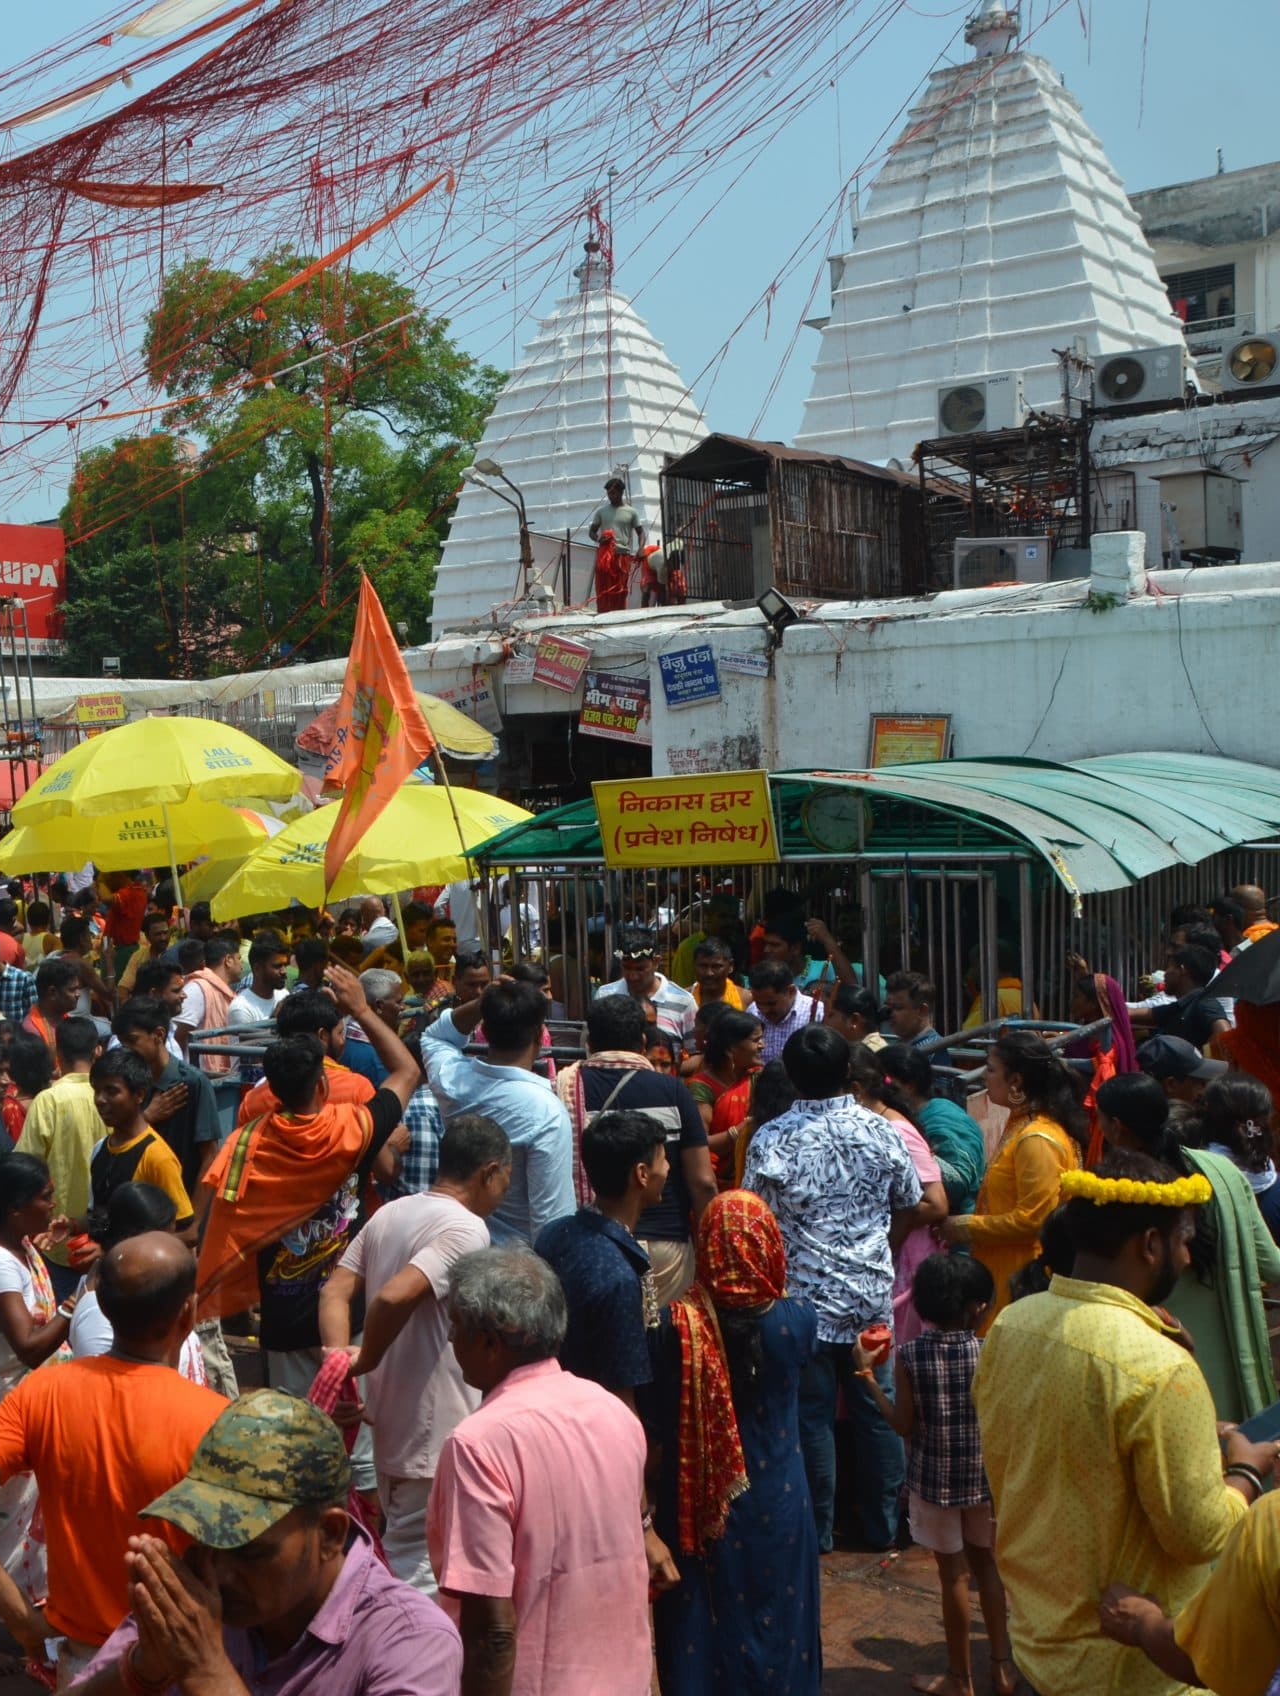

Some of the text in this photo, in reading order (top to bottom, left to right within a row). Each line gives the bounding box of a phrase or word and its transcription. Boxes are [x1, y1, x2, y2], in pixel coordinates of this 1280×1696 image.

[687, 648, 712, 665] पंडा
[586, 689, 639, 711] भीम पंडा
[203, 746, 237, 758] LALL
[205, 756, 252, 770] STEELS
[618, 789, 755, 814] निकास द्वार
[124, 819, 158, 830] LALL
[118, 830, 167, 842] STEELS
[614, 817, 769, 854] (प्रवेश निषेध)
